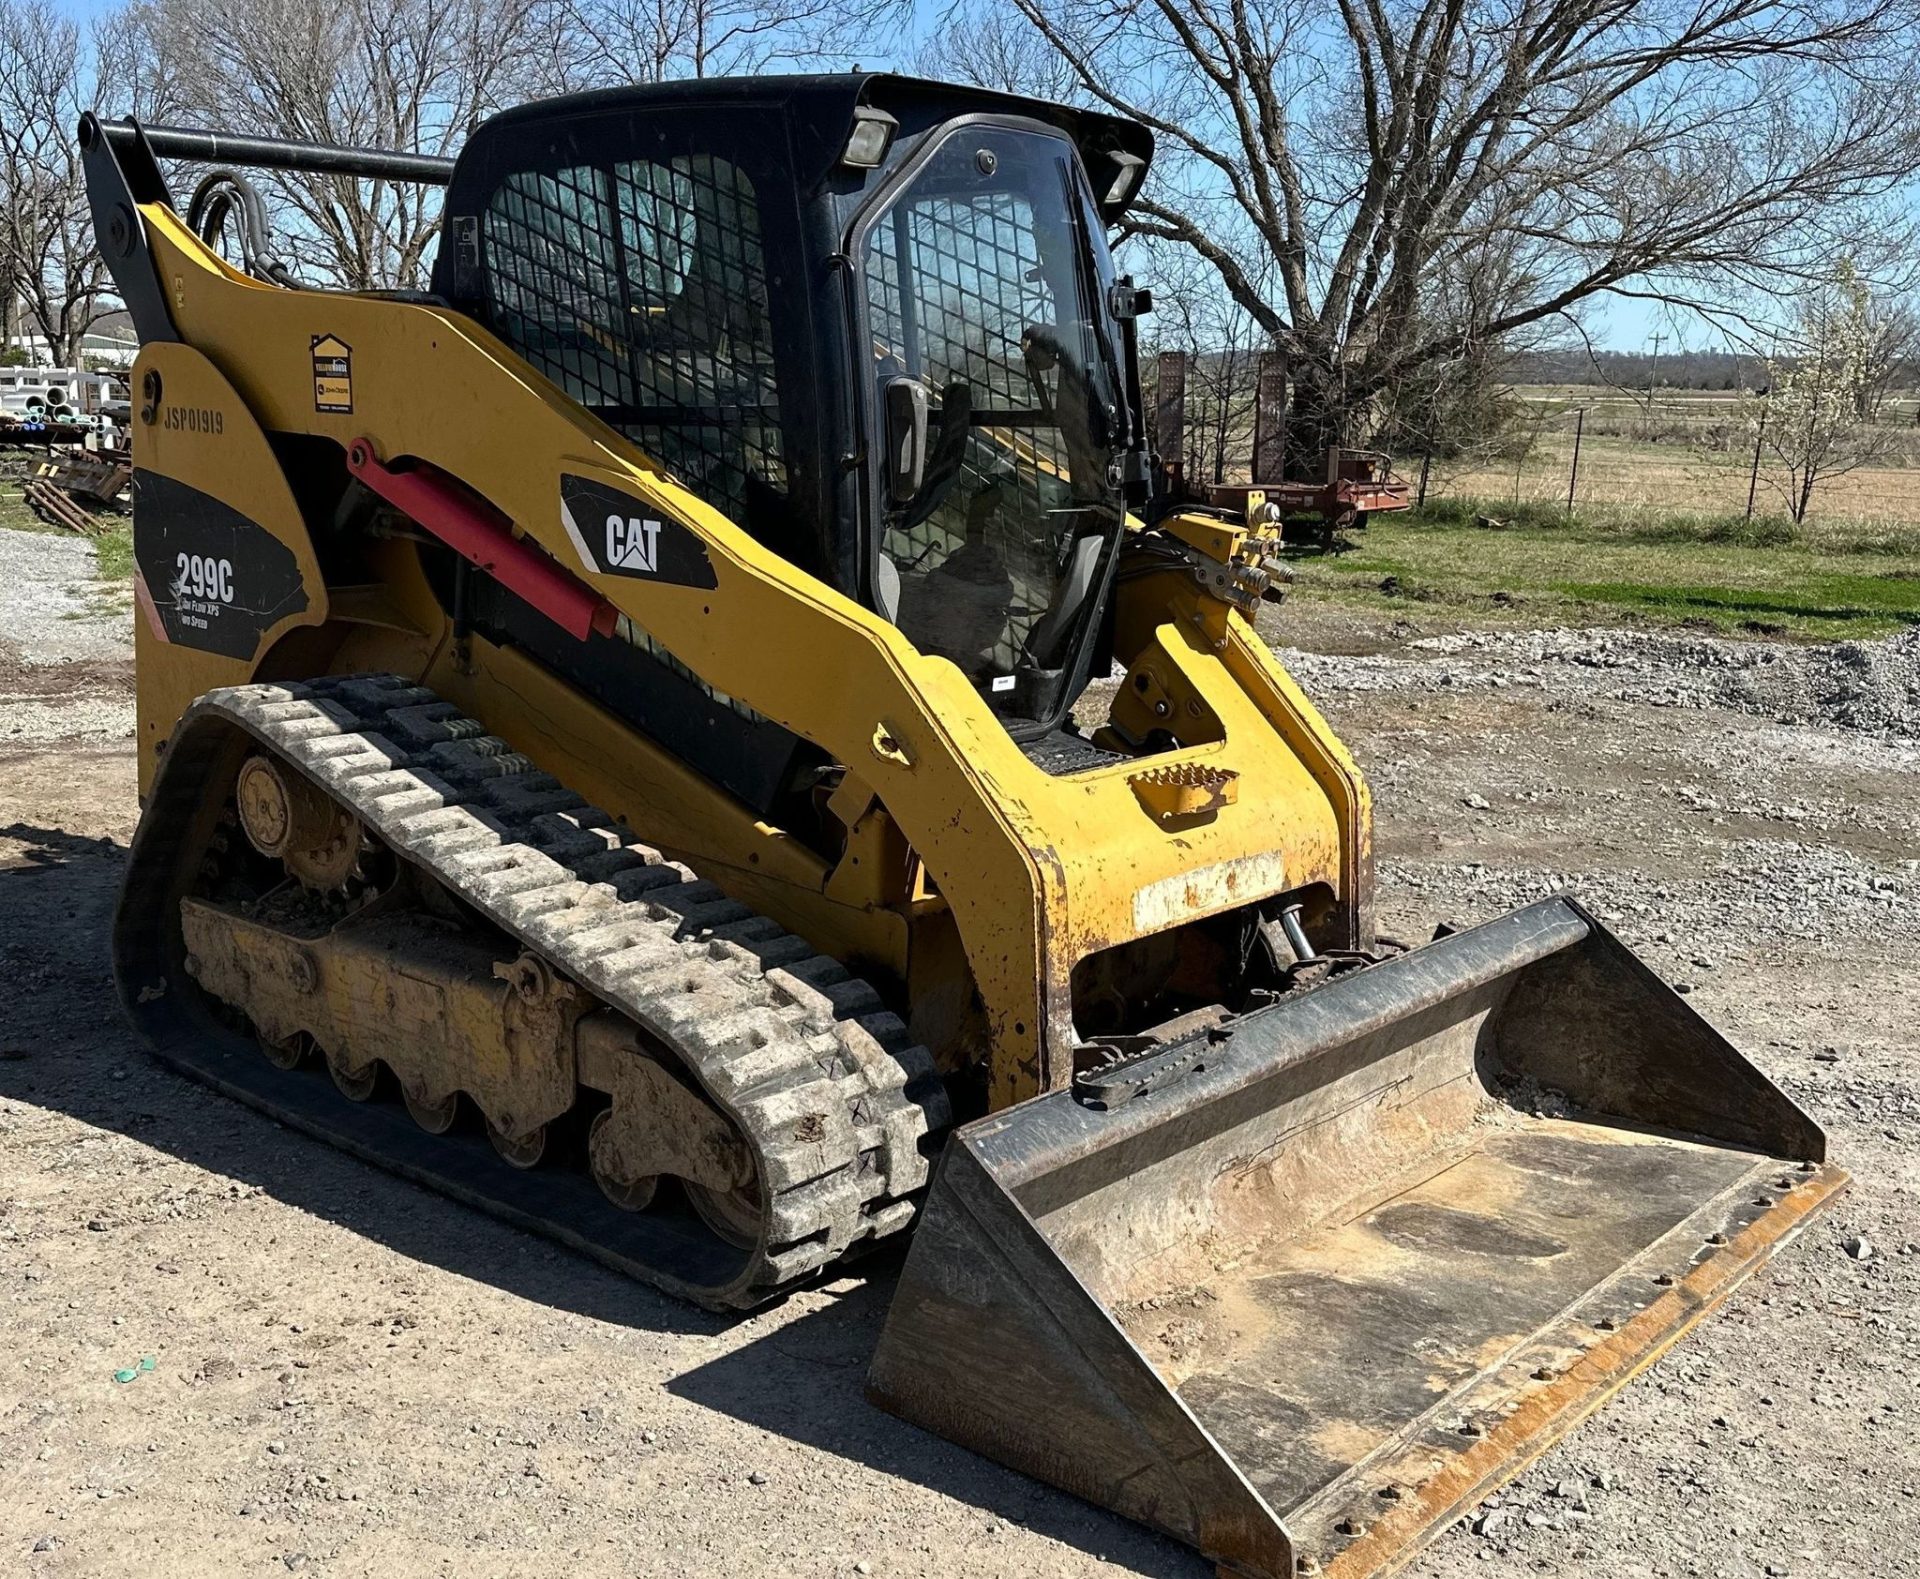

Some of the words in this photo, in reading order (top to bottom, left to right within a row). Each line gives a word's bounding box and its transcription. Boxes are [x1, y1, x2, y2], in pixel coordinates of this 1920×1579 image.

[606, 514, 662, 573] CAT
[177, 552, 234, 603] 299C
[206, 603, 220, 617] XPS
